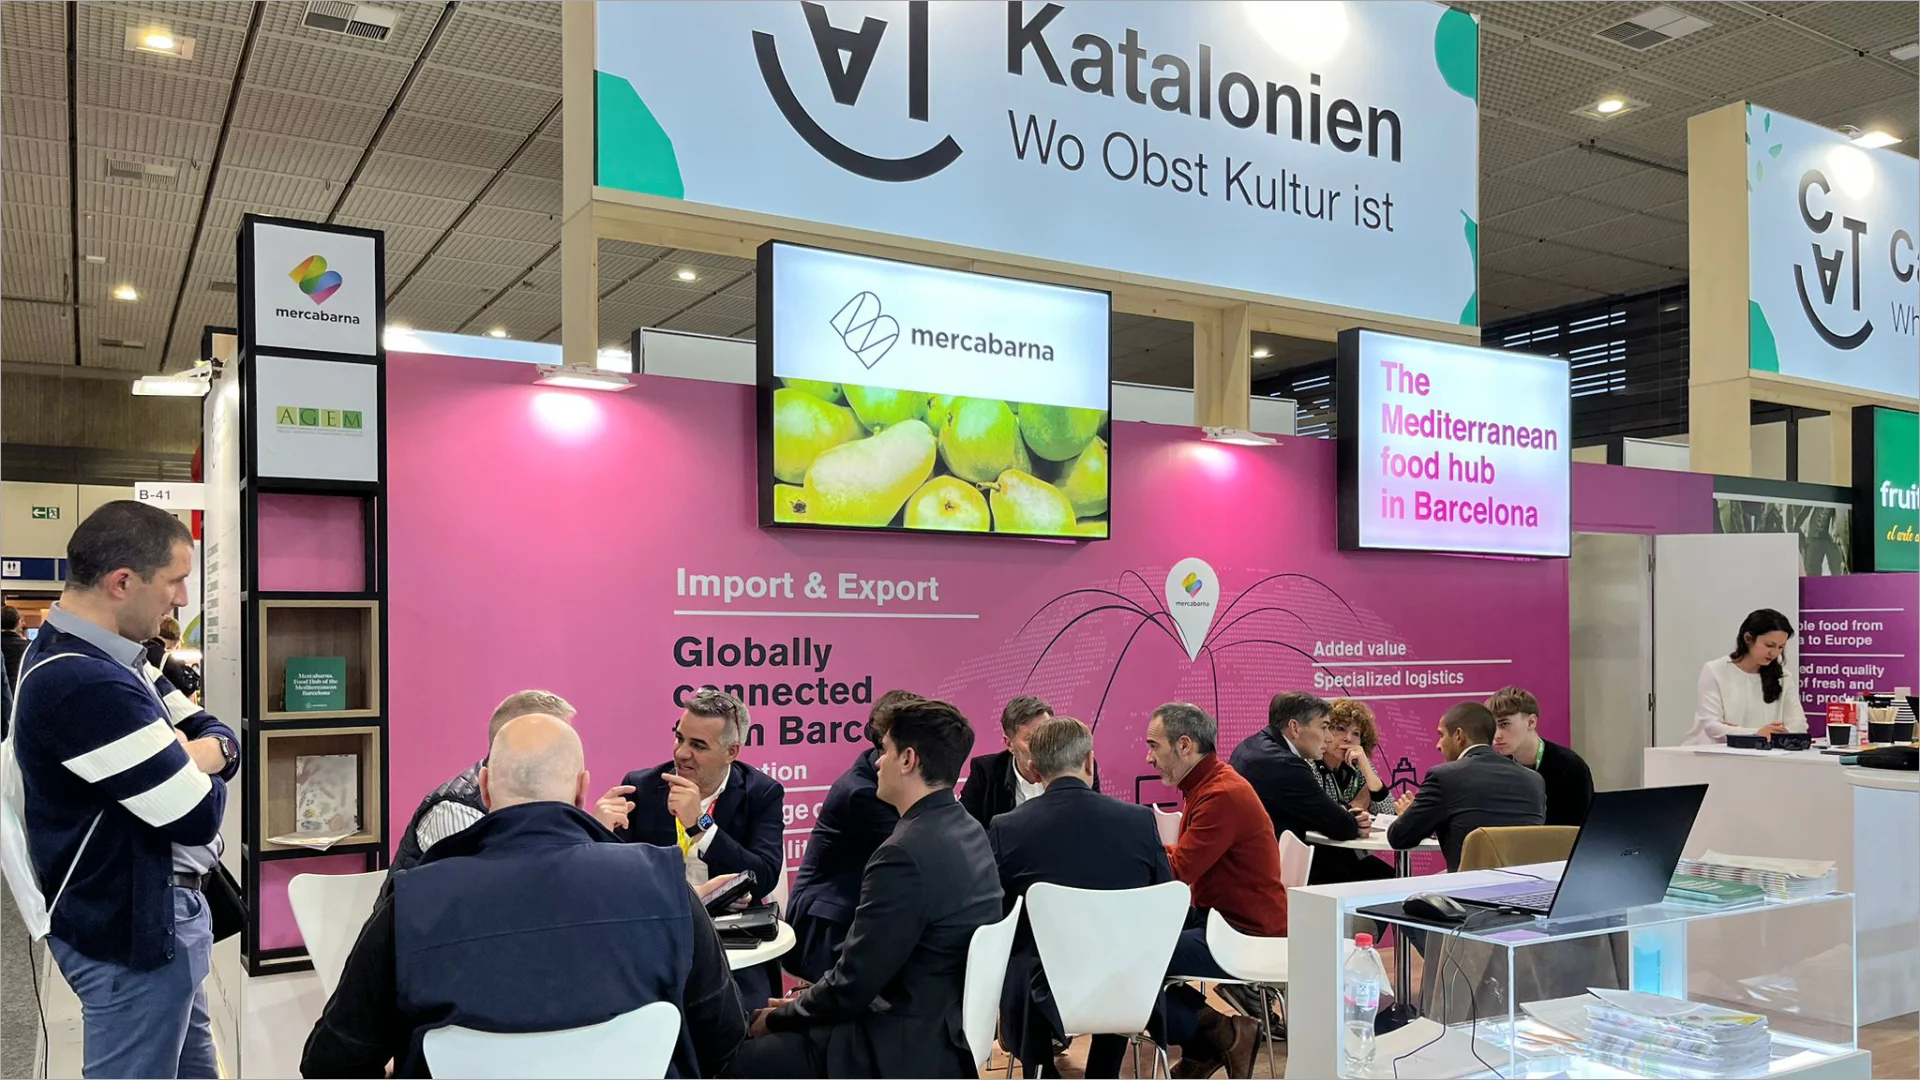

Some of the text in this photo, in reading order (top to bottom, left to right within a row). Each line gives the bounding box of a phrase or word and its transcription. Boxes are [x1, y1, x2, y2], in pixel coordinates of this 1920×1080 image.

[1007, 1, 1401, 163] Katalonien
[1007, 109, 1394, 232] Wo Obst Kultur ist
[1890, 229, 1919, 283] C
[276, 308, 360, 325] mercabarna
[911, 327, 1054, 361] mercabarna
[1380, 360, 1430, 396] The
[279, 407, 361, 428] AGEM
[1381, 403, 1558, 450] Mediterranean
[1381, 446, 1495, 485] food hub
[140, 489, 170, 500] B-41
[1381, 488, 1538, 527] in Barcelona
[677, 568, 939, 606] Import & Export
[1808, 634, 1821, 645] to
[1825, 634, 1873, 648] Europe
[1819, 620, 1848, 631] food
[1852, 619, 1883, 631] from
[673, 636, 832, 673] Globally
[1313, 641, 1406, 656] Added value
[1313, 669, 1464, 690] Specialized logistics
[1812, 678, 1845, 689] fresh
[1849, 679, 1874, 690] and
[1816, 664, 1839, 675] and
[1842, 664, 1885, 678] quality
